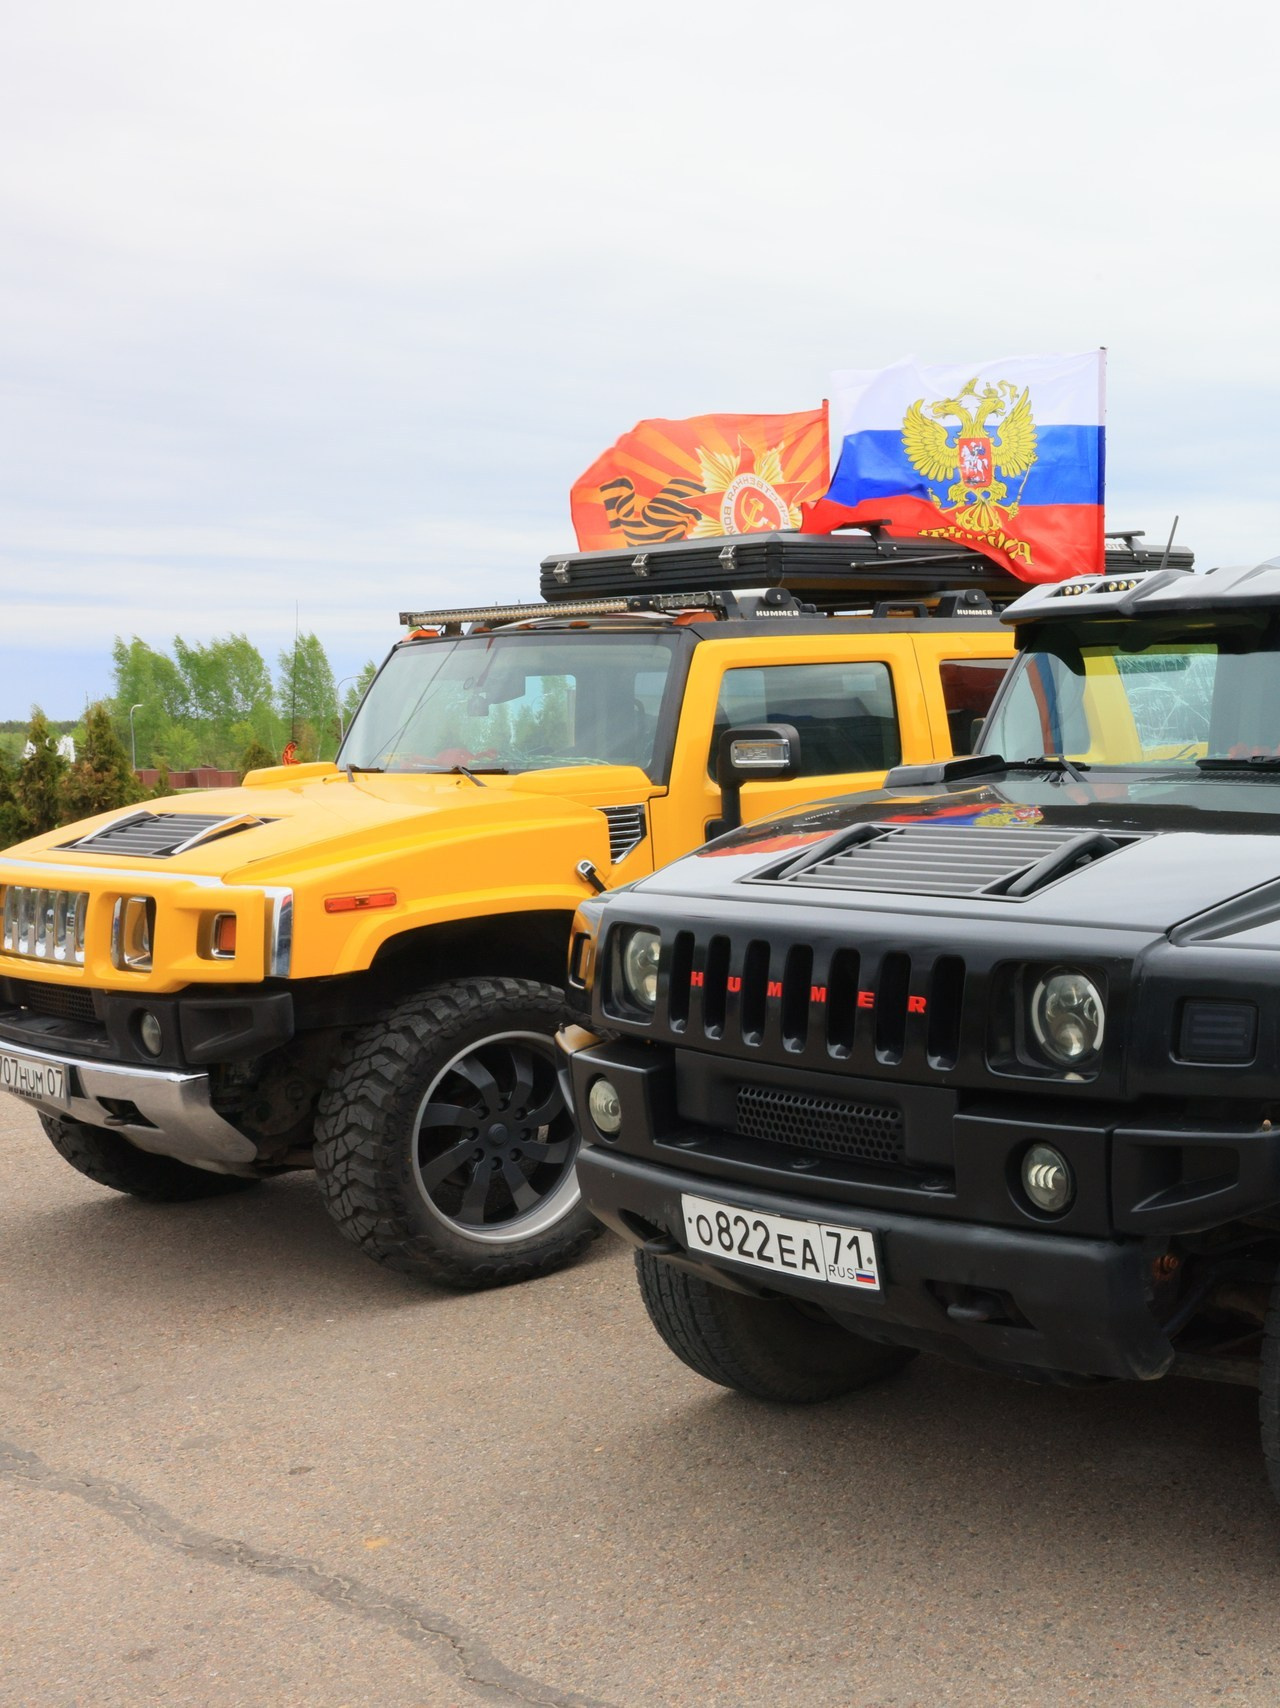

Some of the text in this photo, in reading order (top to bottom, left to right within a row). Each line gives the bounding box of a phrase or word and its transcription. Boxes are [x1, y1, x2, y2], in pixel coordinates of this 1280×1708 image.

[690, 971, 927, 1014] HUMMER
[47, 1068, 63, 1098] 07
[696, 1210, 863, 1273] О822ЕА 71
[829, 1264, 855, 1280] RUS
